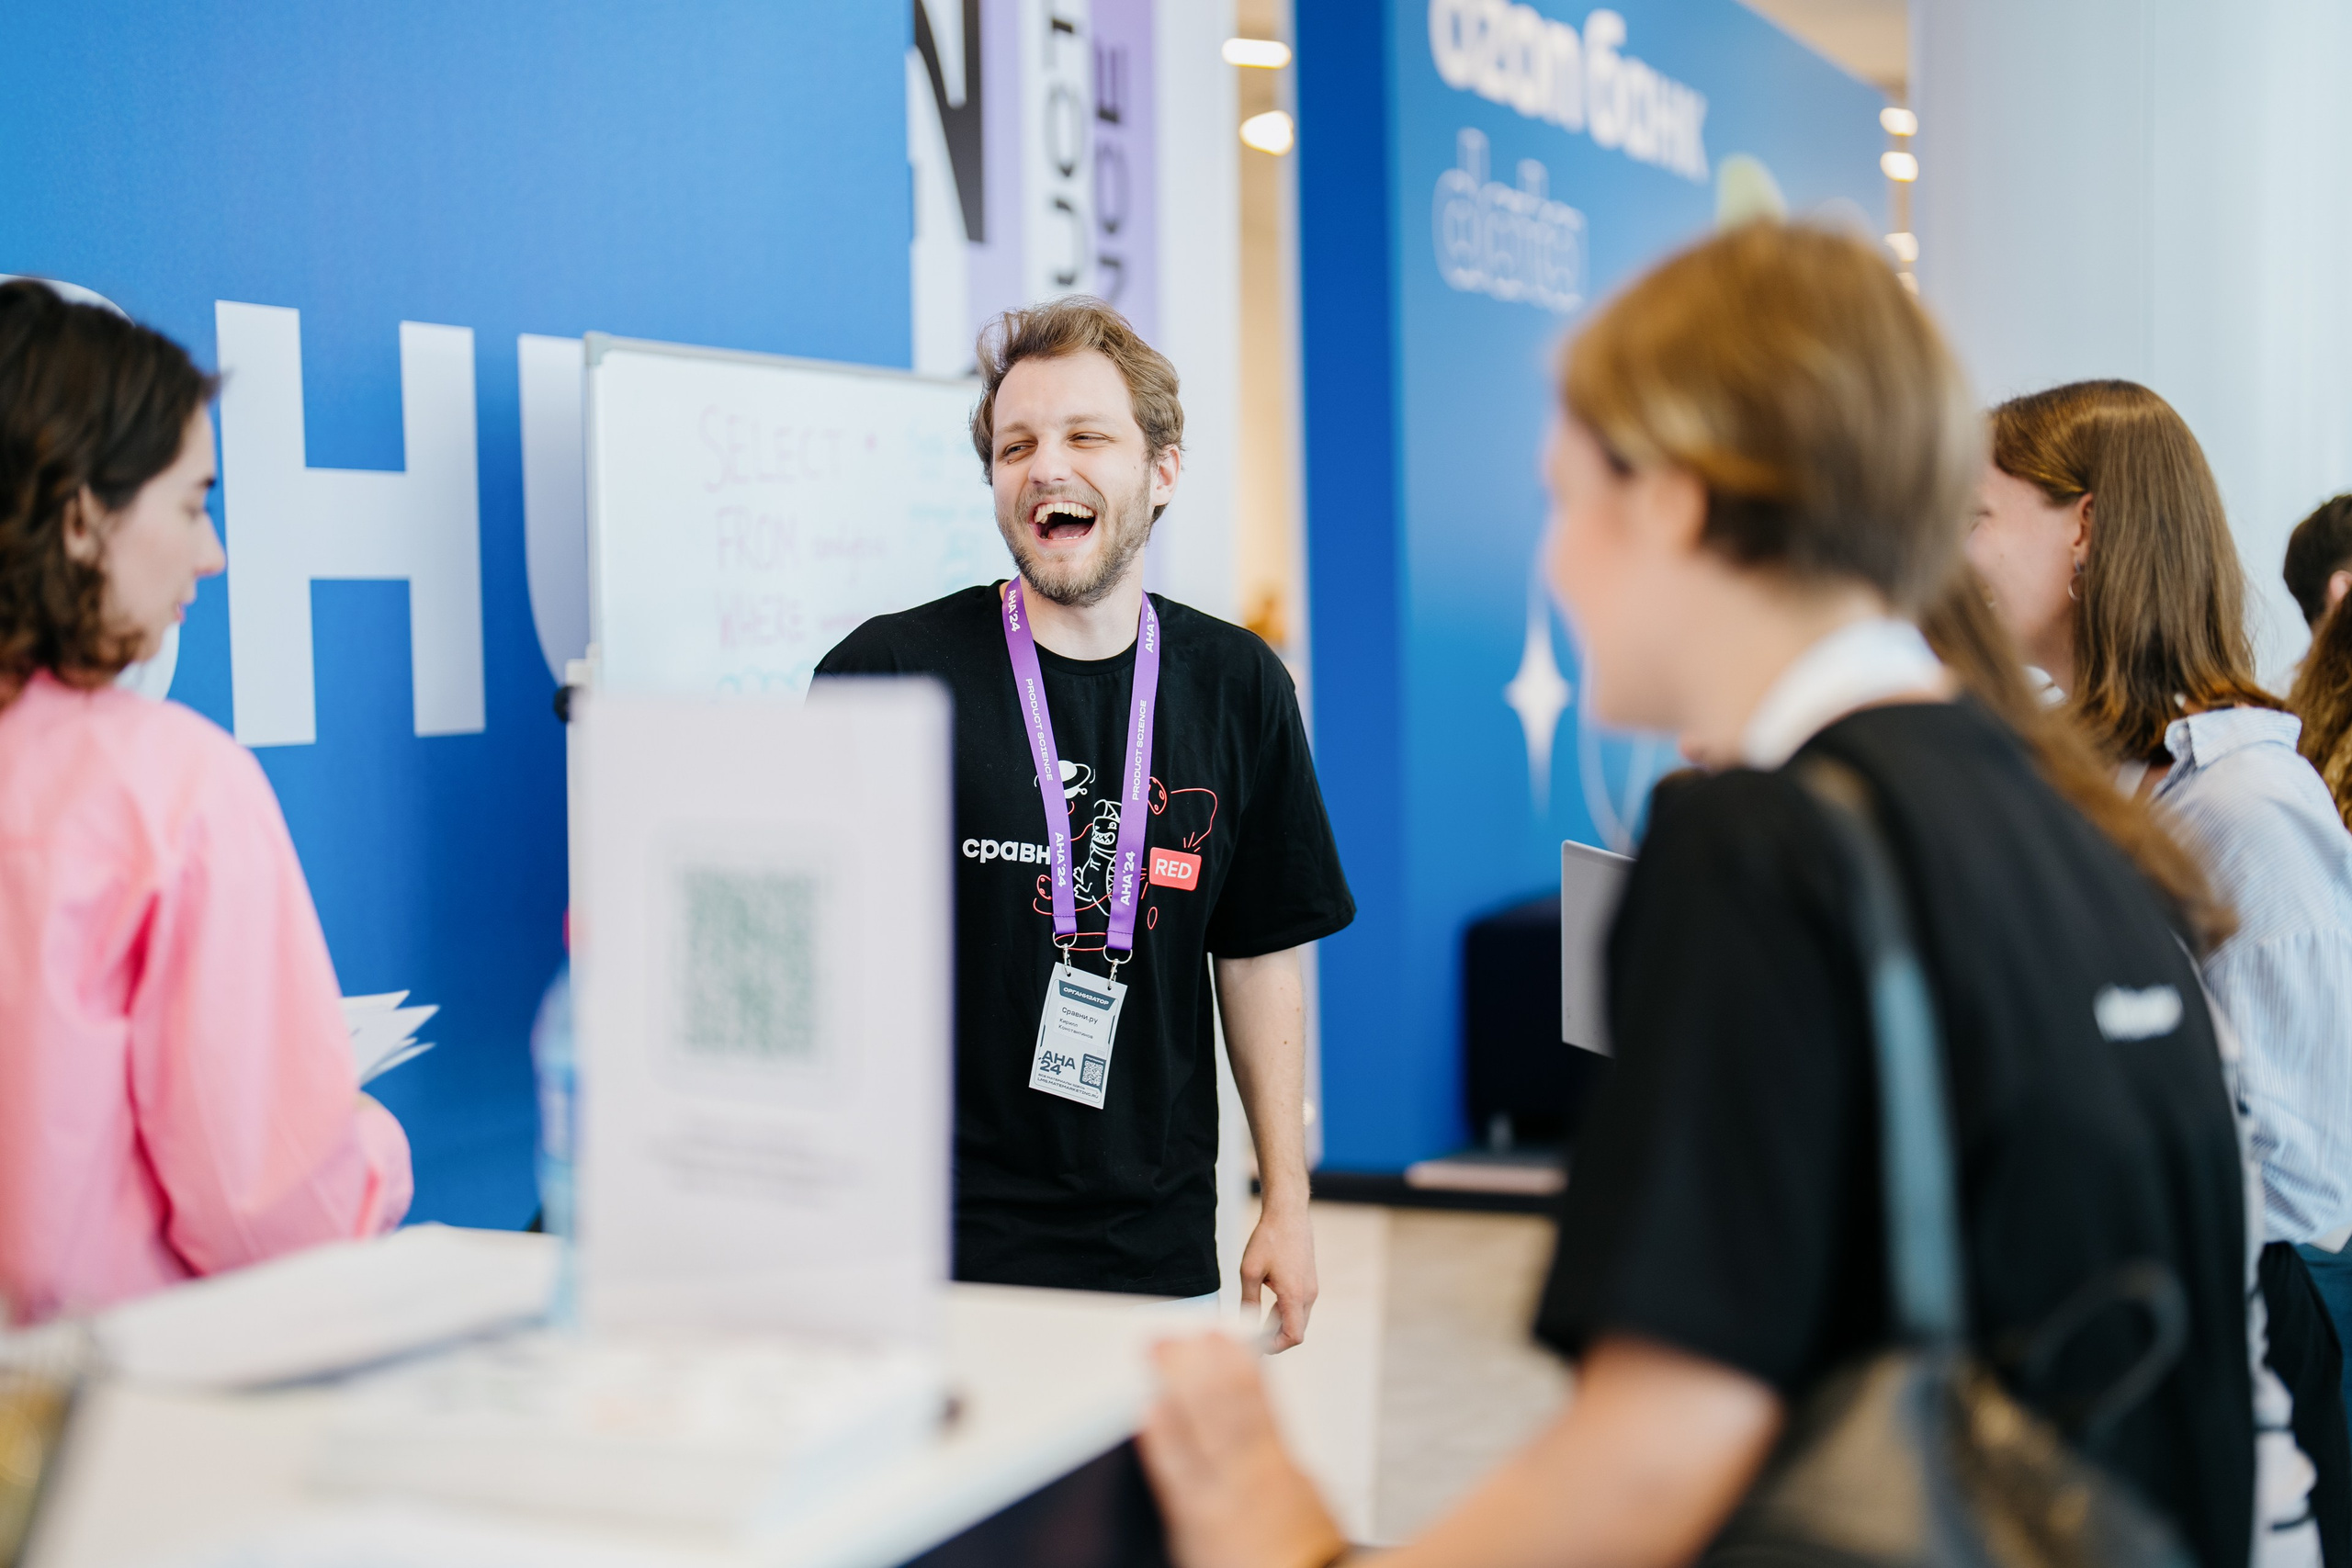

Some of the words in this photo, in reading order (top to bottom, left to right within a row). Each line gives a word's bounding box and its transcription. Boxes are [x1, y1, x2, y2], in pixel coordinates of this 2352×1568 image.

[699, 403, 844, 494] SELECT
[715, 503, 800, 571] FROM
[1025, 678, 1043, 731] PRODUCT
[1037, 731, 1053, 782] SCIENCE
[1137, 699, 1147, 748] SCIENCE
[1132, 749, 1143, 801] PRODUCT
[962, 838, 1052, 865] сравн
[1154, 858, 1193, 880] RED
[1061, 1007, 1098, 1025] Сравни.ру
[1063, 987, 1110, 1006] ОРГАНИЗАТОР
